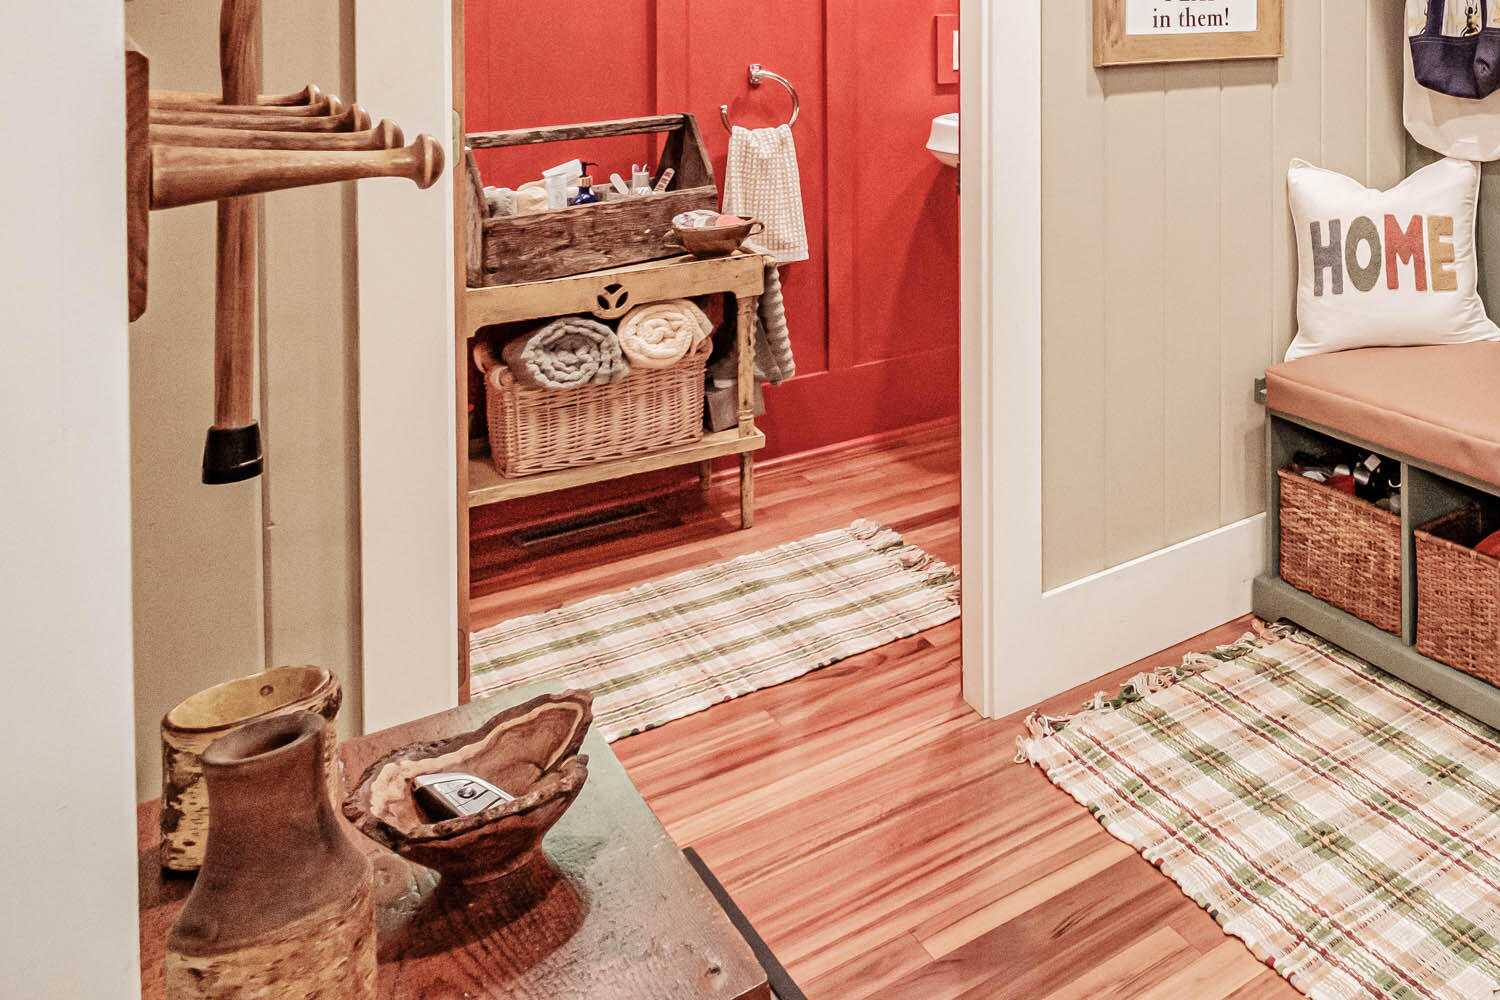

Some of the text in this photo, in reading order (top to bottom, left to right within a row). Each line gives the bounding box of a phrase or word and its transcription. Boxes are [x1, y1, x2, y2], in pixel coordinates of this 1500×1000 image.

[1152, 6, 1230, 28] in them!
[1309, 213, 1458, 297] HOME
